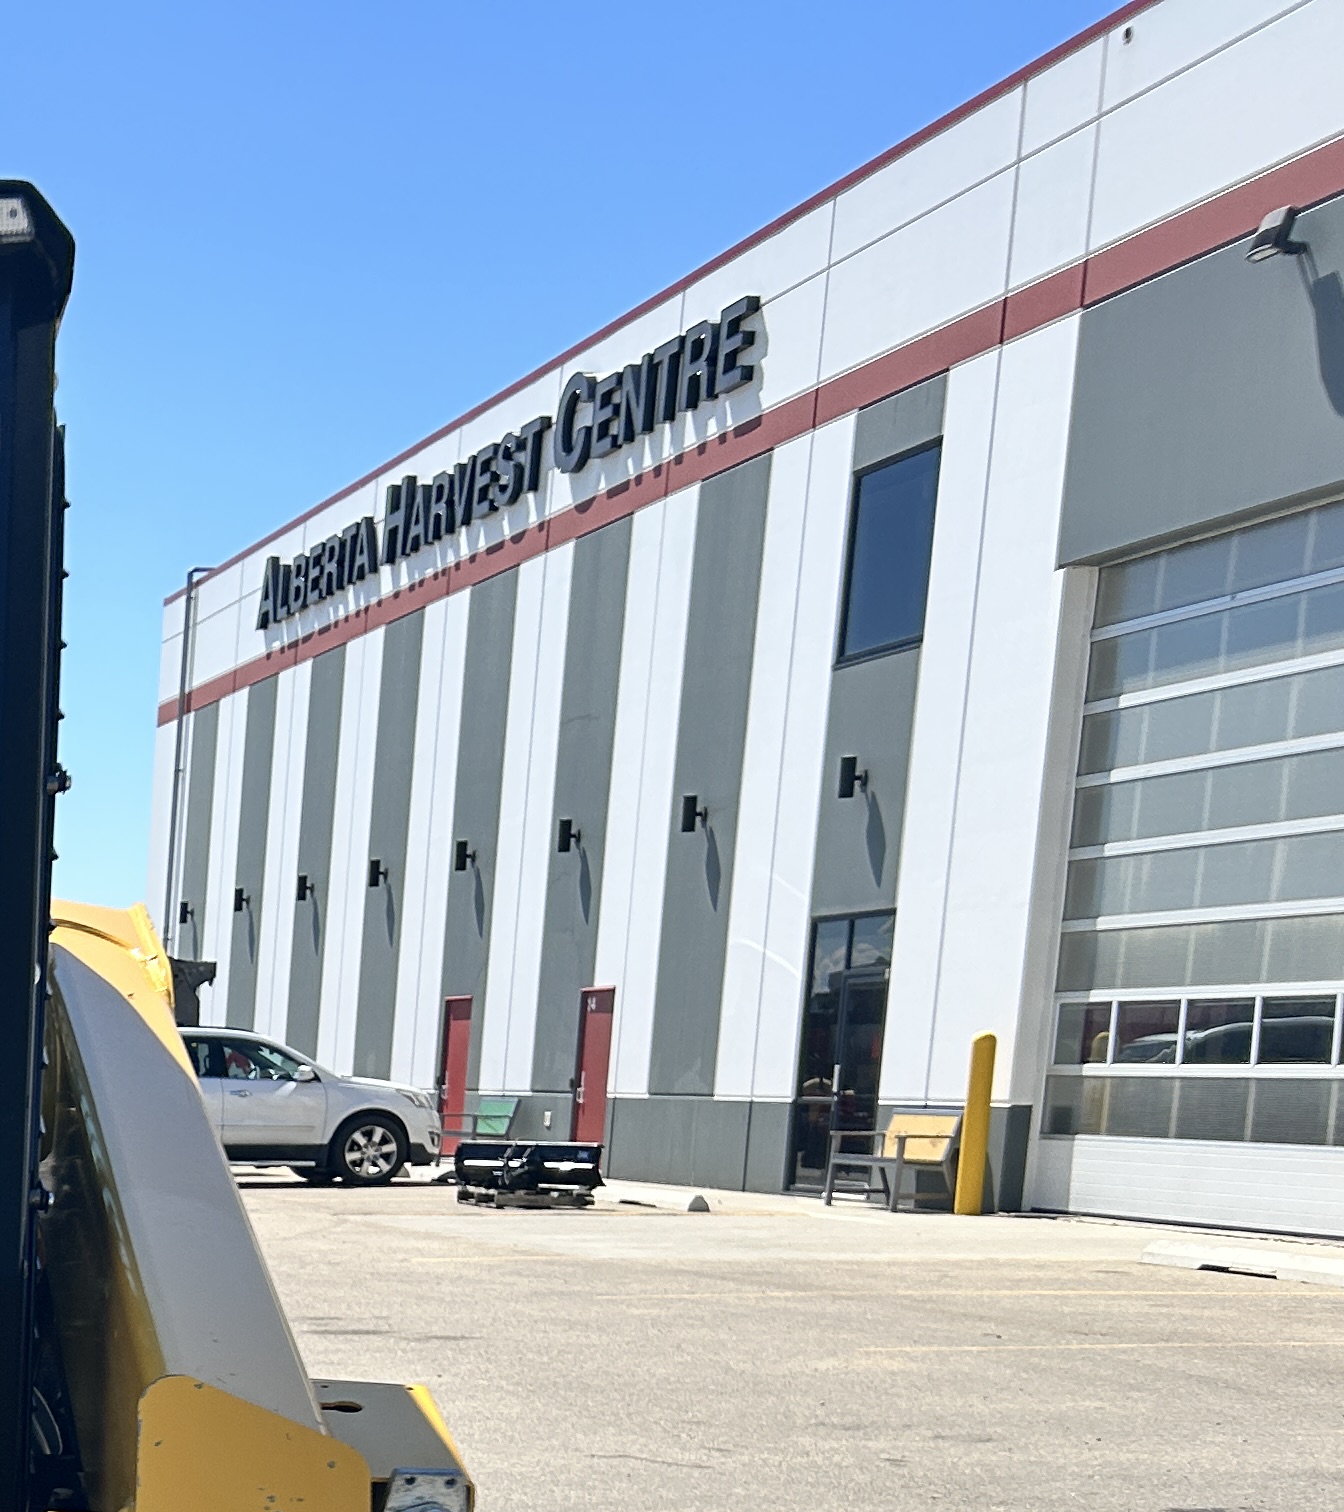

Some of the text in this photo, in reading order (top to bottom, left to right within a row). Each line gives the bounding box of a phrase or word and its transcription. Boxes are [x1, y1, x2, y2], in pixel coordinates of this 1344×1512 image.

[256, 295, 761, 630] ALBERTA HARVEST CENTRE
